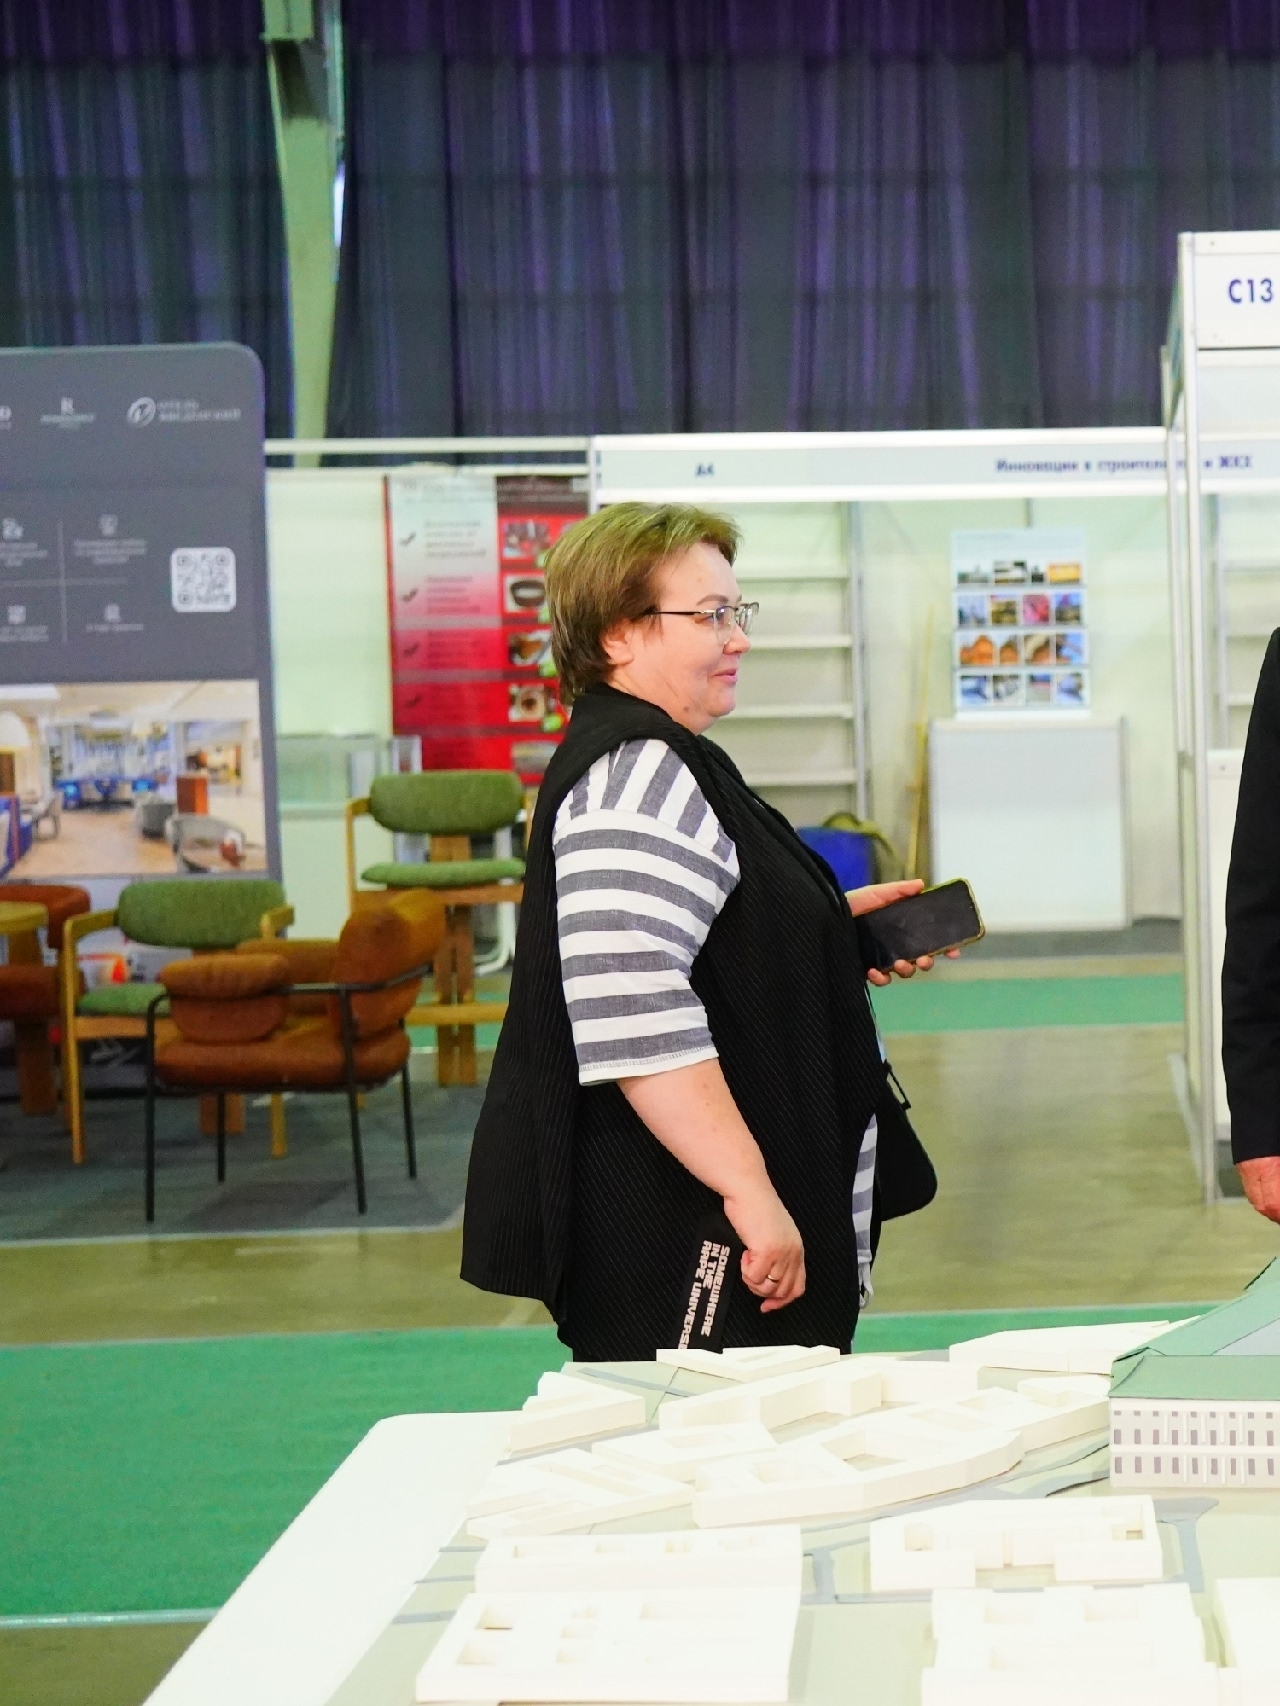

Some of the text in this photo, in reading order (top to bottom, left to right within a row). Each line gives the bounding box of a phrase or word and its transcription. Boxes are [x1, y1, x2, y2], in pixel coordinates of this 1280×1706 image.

[1228, 278, 1274, 303] C13
[996, 459, 1079, 473] Инновации
[702, 1243, 722, 1289] IN THE
[702, 1245, 731, 1337] SOMEWHERE
